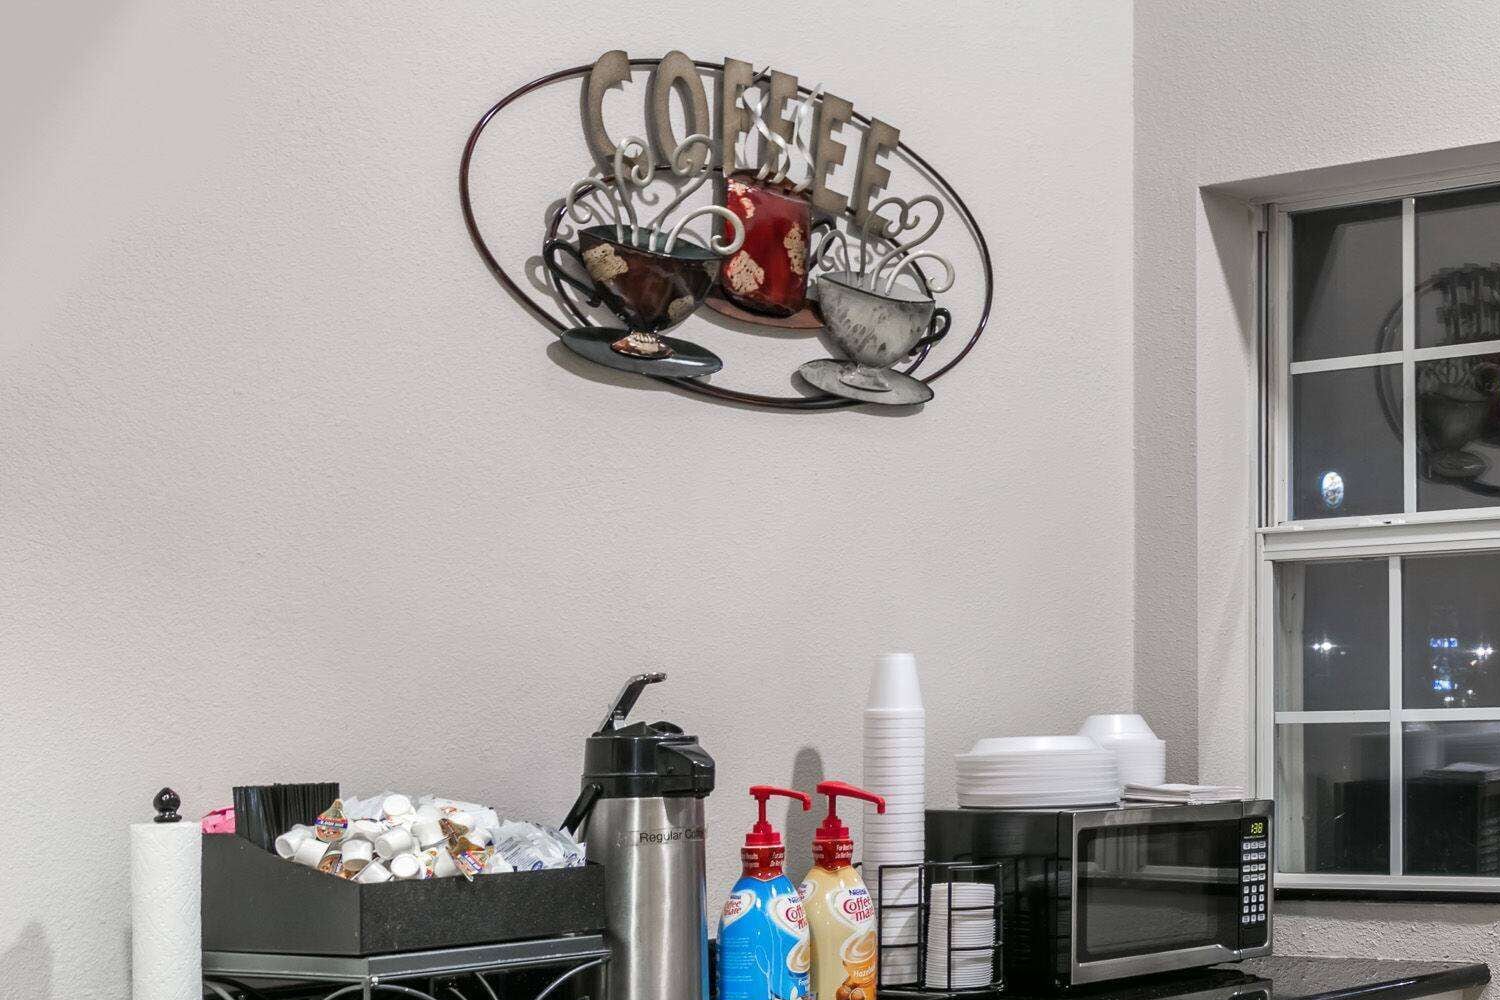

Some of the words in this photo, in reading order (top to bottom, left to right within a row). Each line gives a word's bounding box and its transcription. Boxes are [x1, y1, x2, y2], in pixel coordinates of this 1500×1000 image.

[588, 49, 902, 238] COFFEE
[639, 831, 682, 844] Regular
[785, 904, 804, 923] Coff
